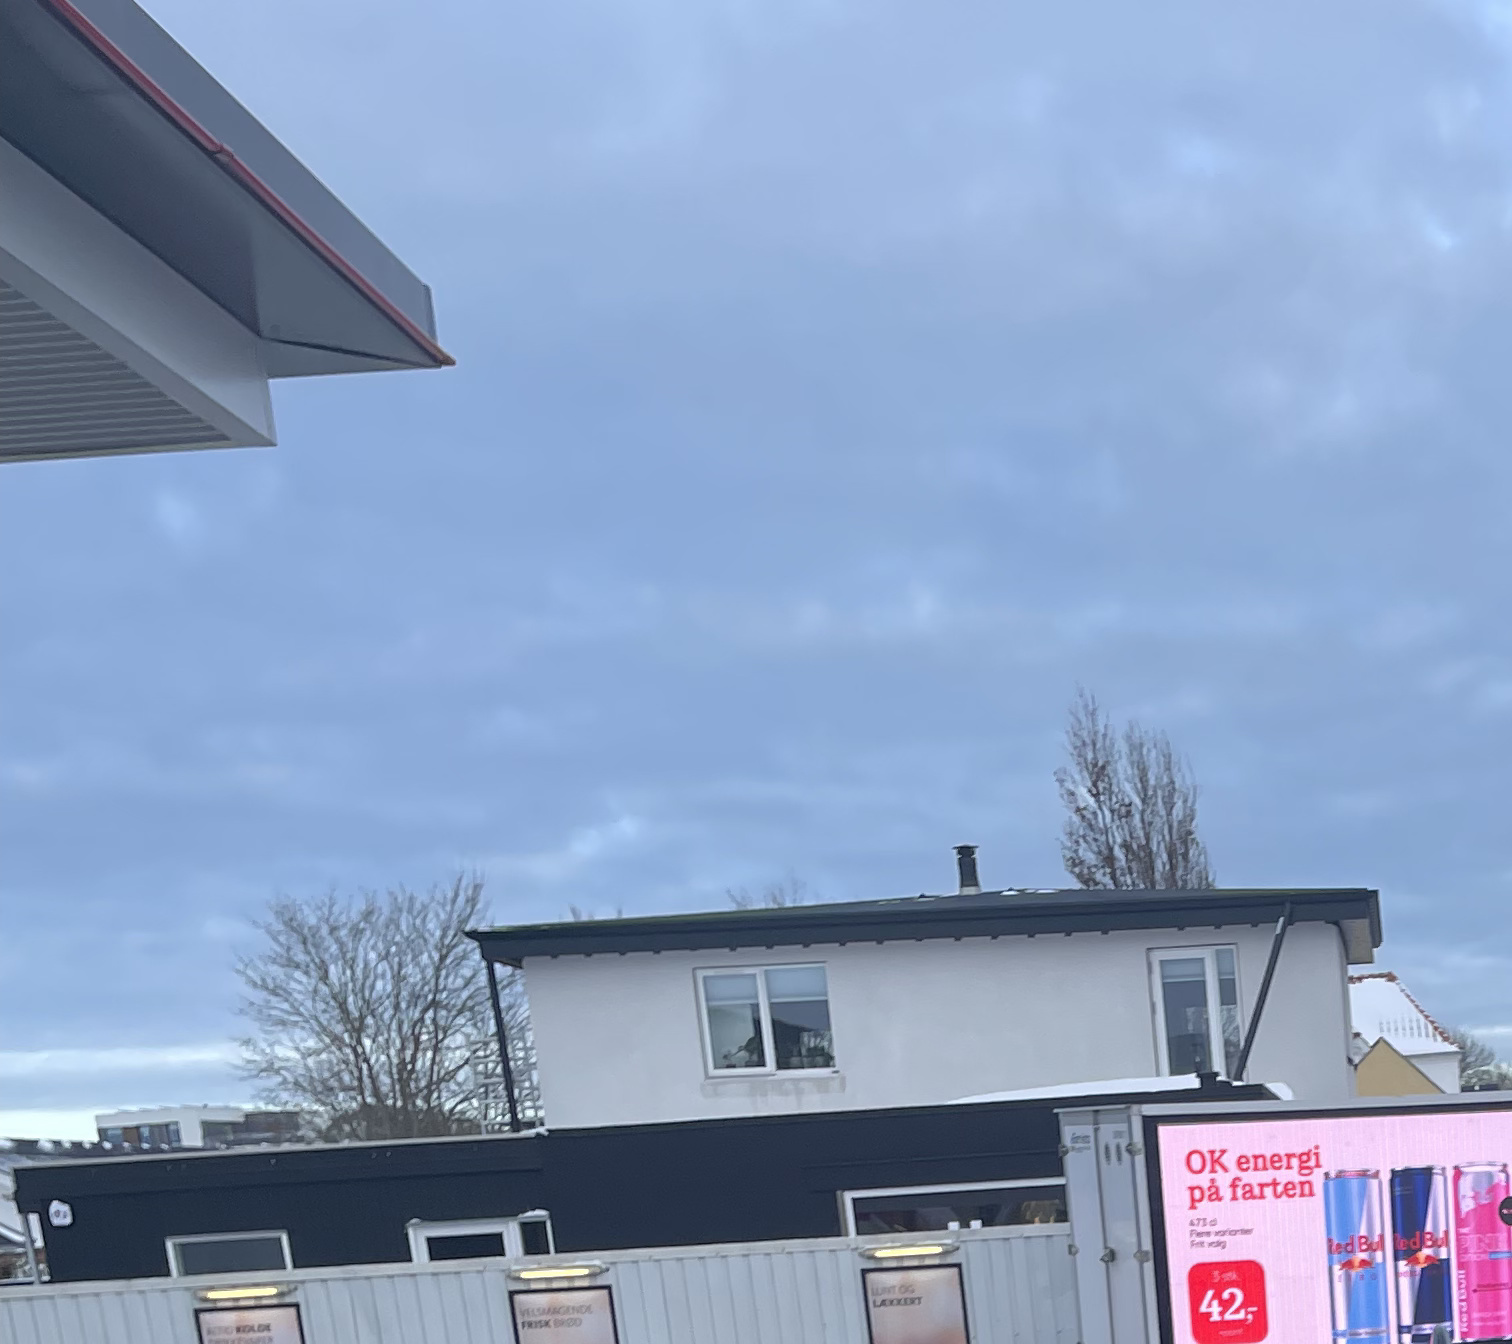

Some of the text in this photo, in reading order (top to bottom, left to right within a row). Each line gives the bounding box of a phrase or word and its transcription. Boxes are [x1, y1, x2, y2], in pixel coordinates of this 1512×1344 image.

[1185, 1144, 1322, 1177] OK energi
[1187, 1176, 1316, 1210] på farten
